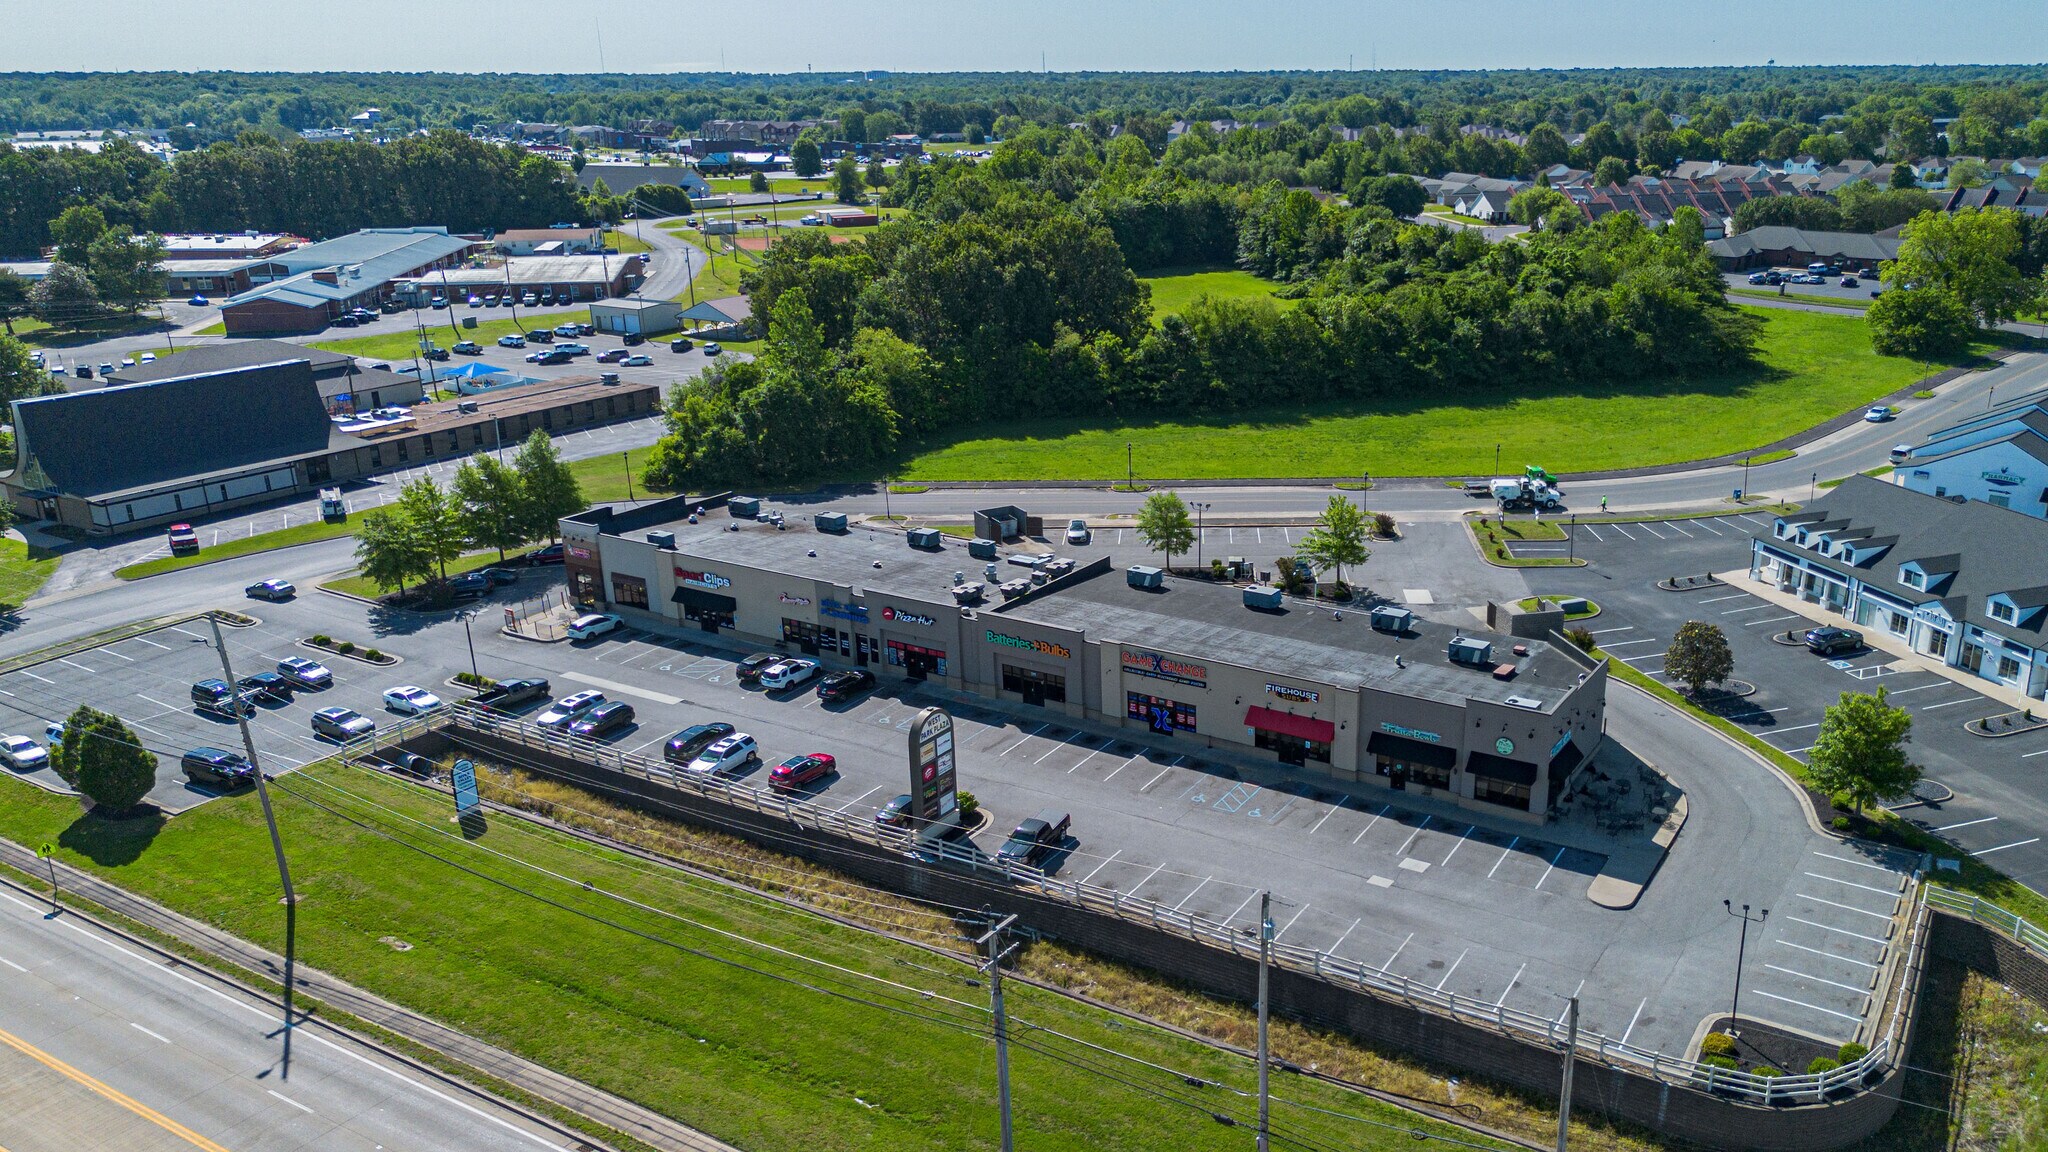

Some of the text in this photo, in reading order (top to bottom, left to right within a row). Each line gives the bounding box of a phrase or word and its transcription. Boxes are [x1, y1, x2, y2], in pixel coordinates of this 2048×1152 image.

[894, 609, 935, 627] Pizza Hut
[1265, 683, 1319, 704] FIREHOUSE
[1281, 693, 1302, 702] SUBS
[920, 719, 950, 740] PARK PLAZA
[927, 714, 941, 727] WEST
